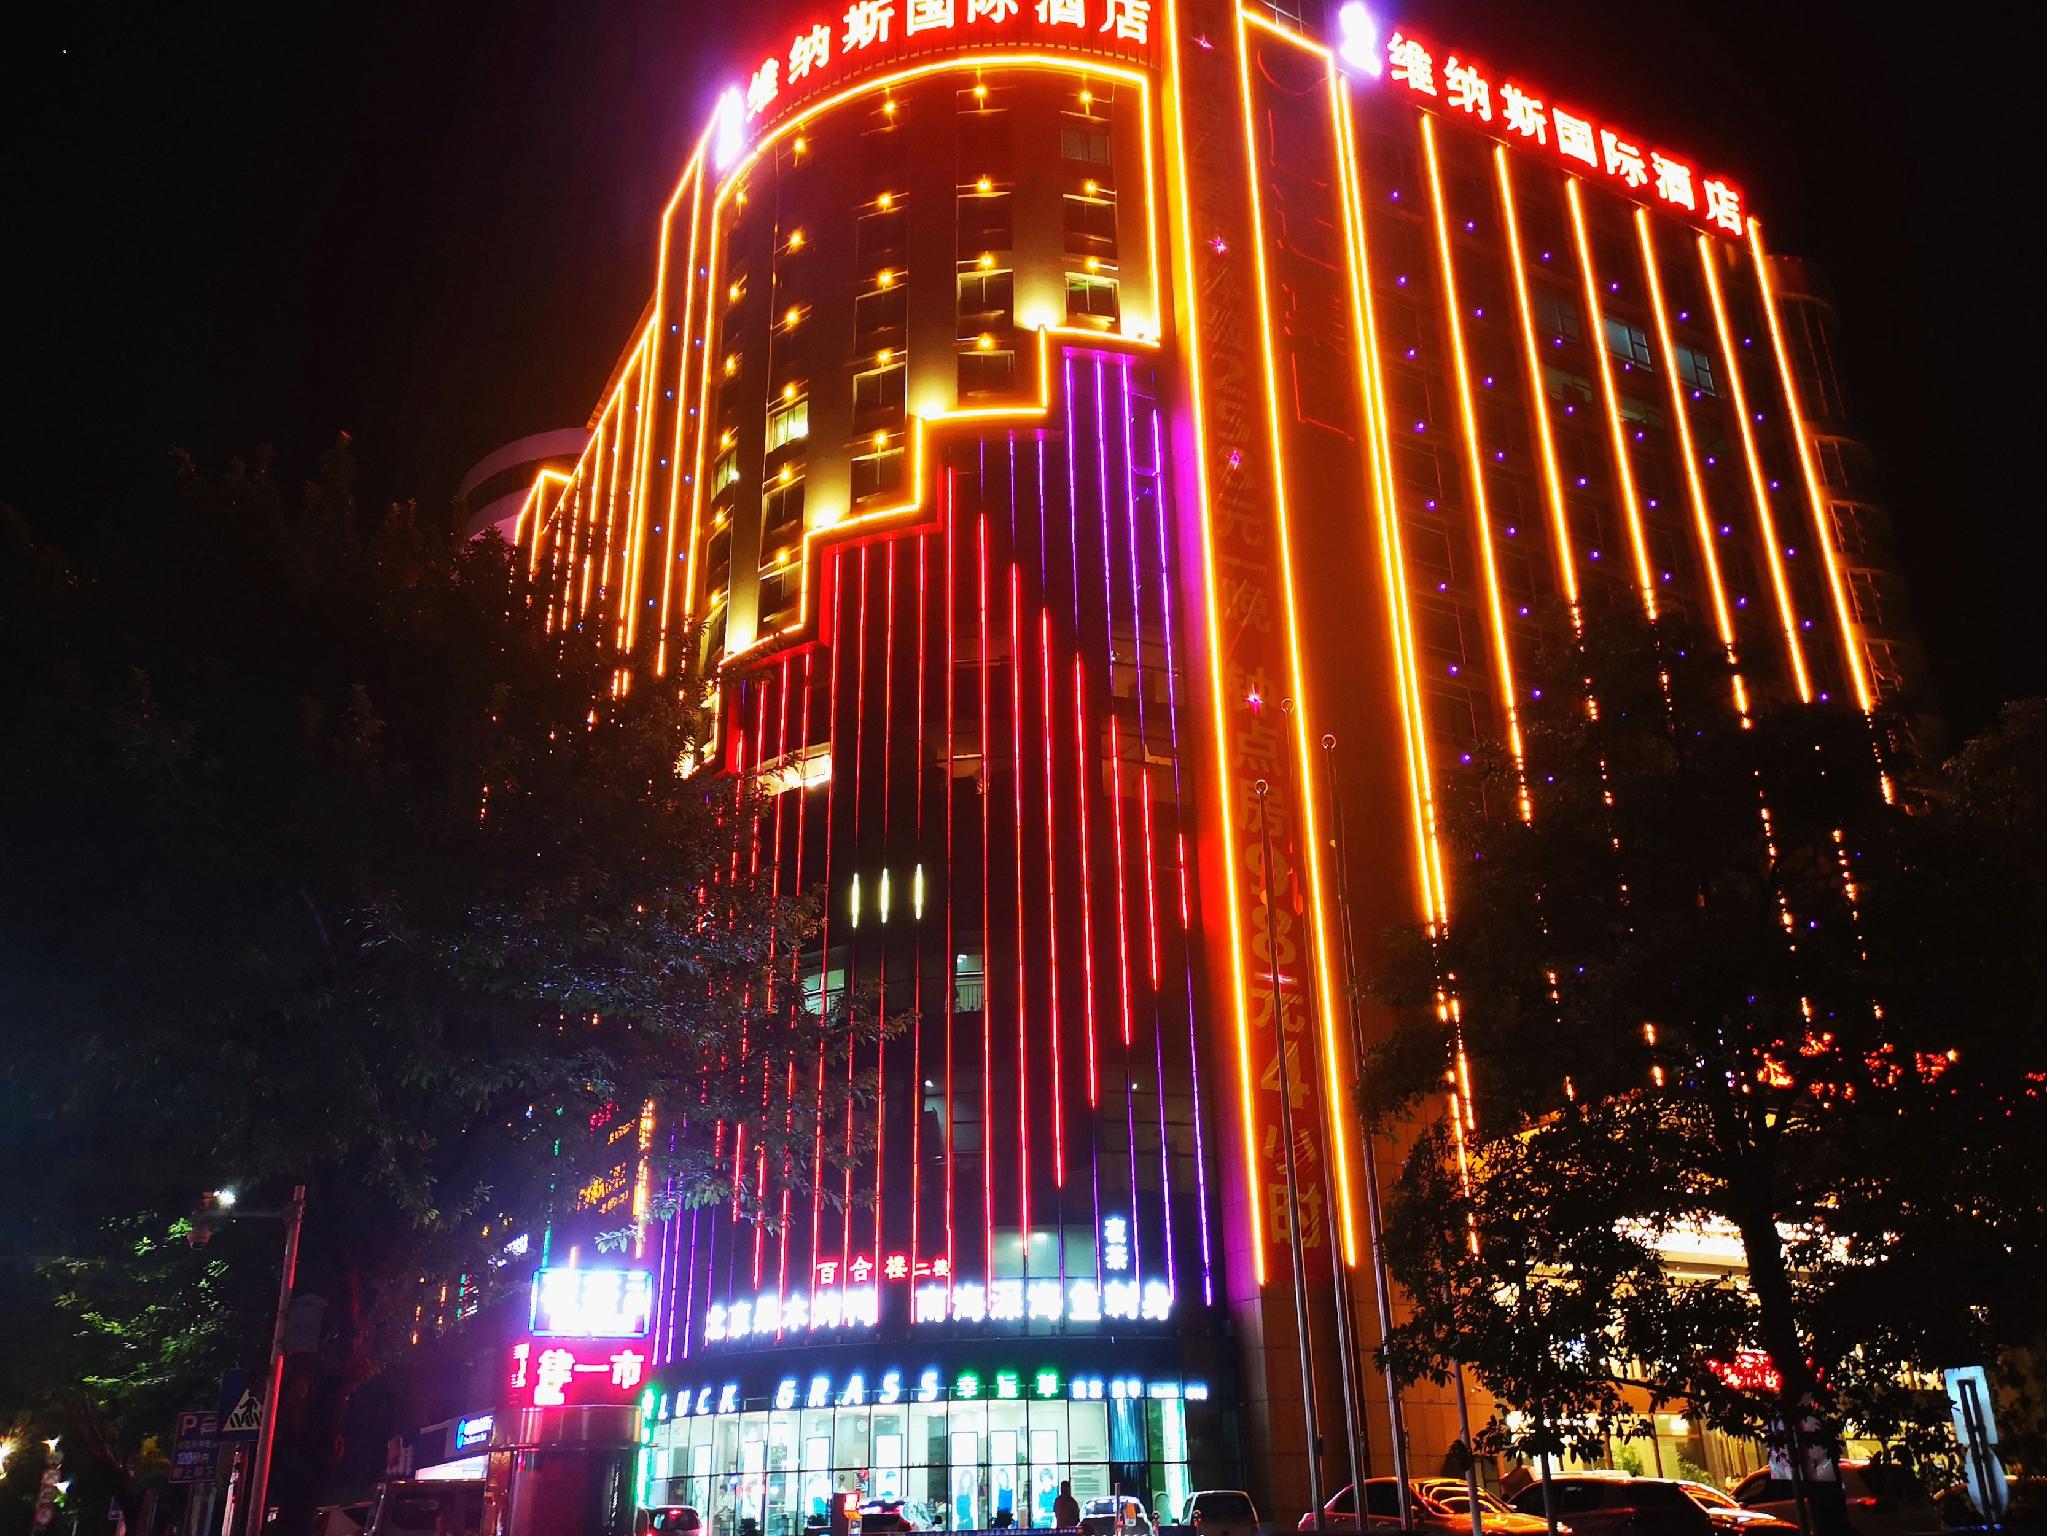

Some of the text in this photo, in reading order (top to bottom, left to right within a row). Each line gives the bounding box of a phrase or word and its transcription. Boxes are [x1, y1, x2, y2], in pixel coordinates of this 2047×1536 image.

[746, 0, 1151, 122] 维纳斯国际酒店
[1386, 31, 1746, 237] 维纳斯国际酒店
[658, 1384, 737, 1420] LUCK
[775, 1372, 938, 1410] GRASS
